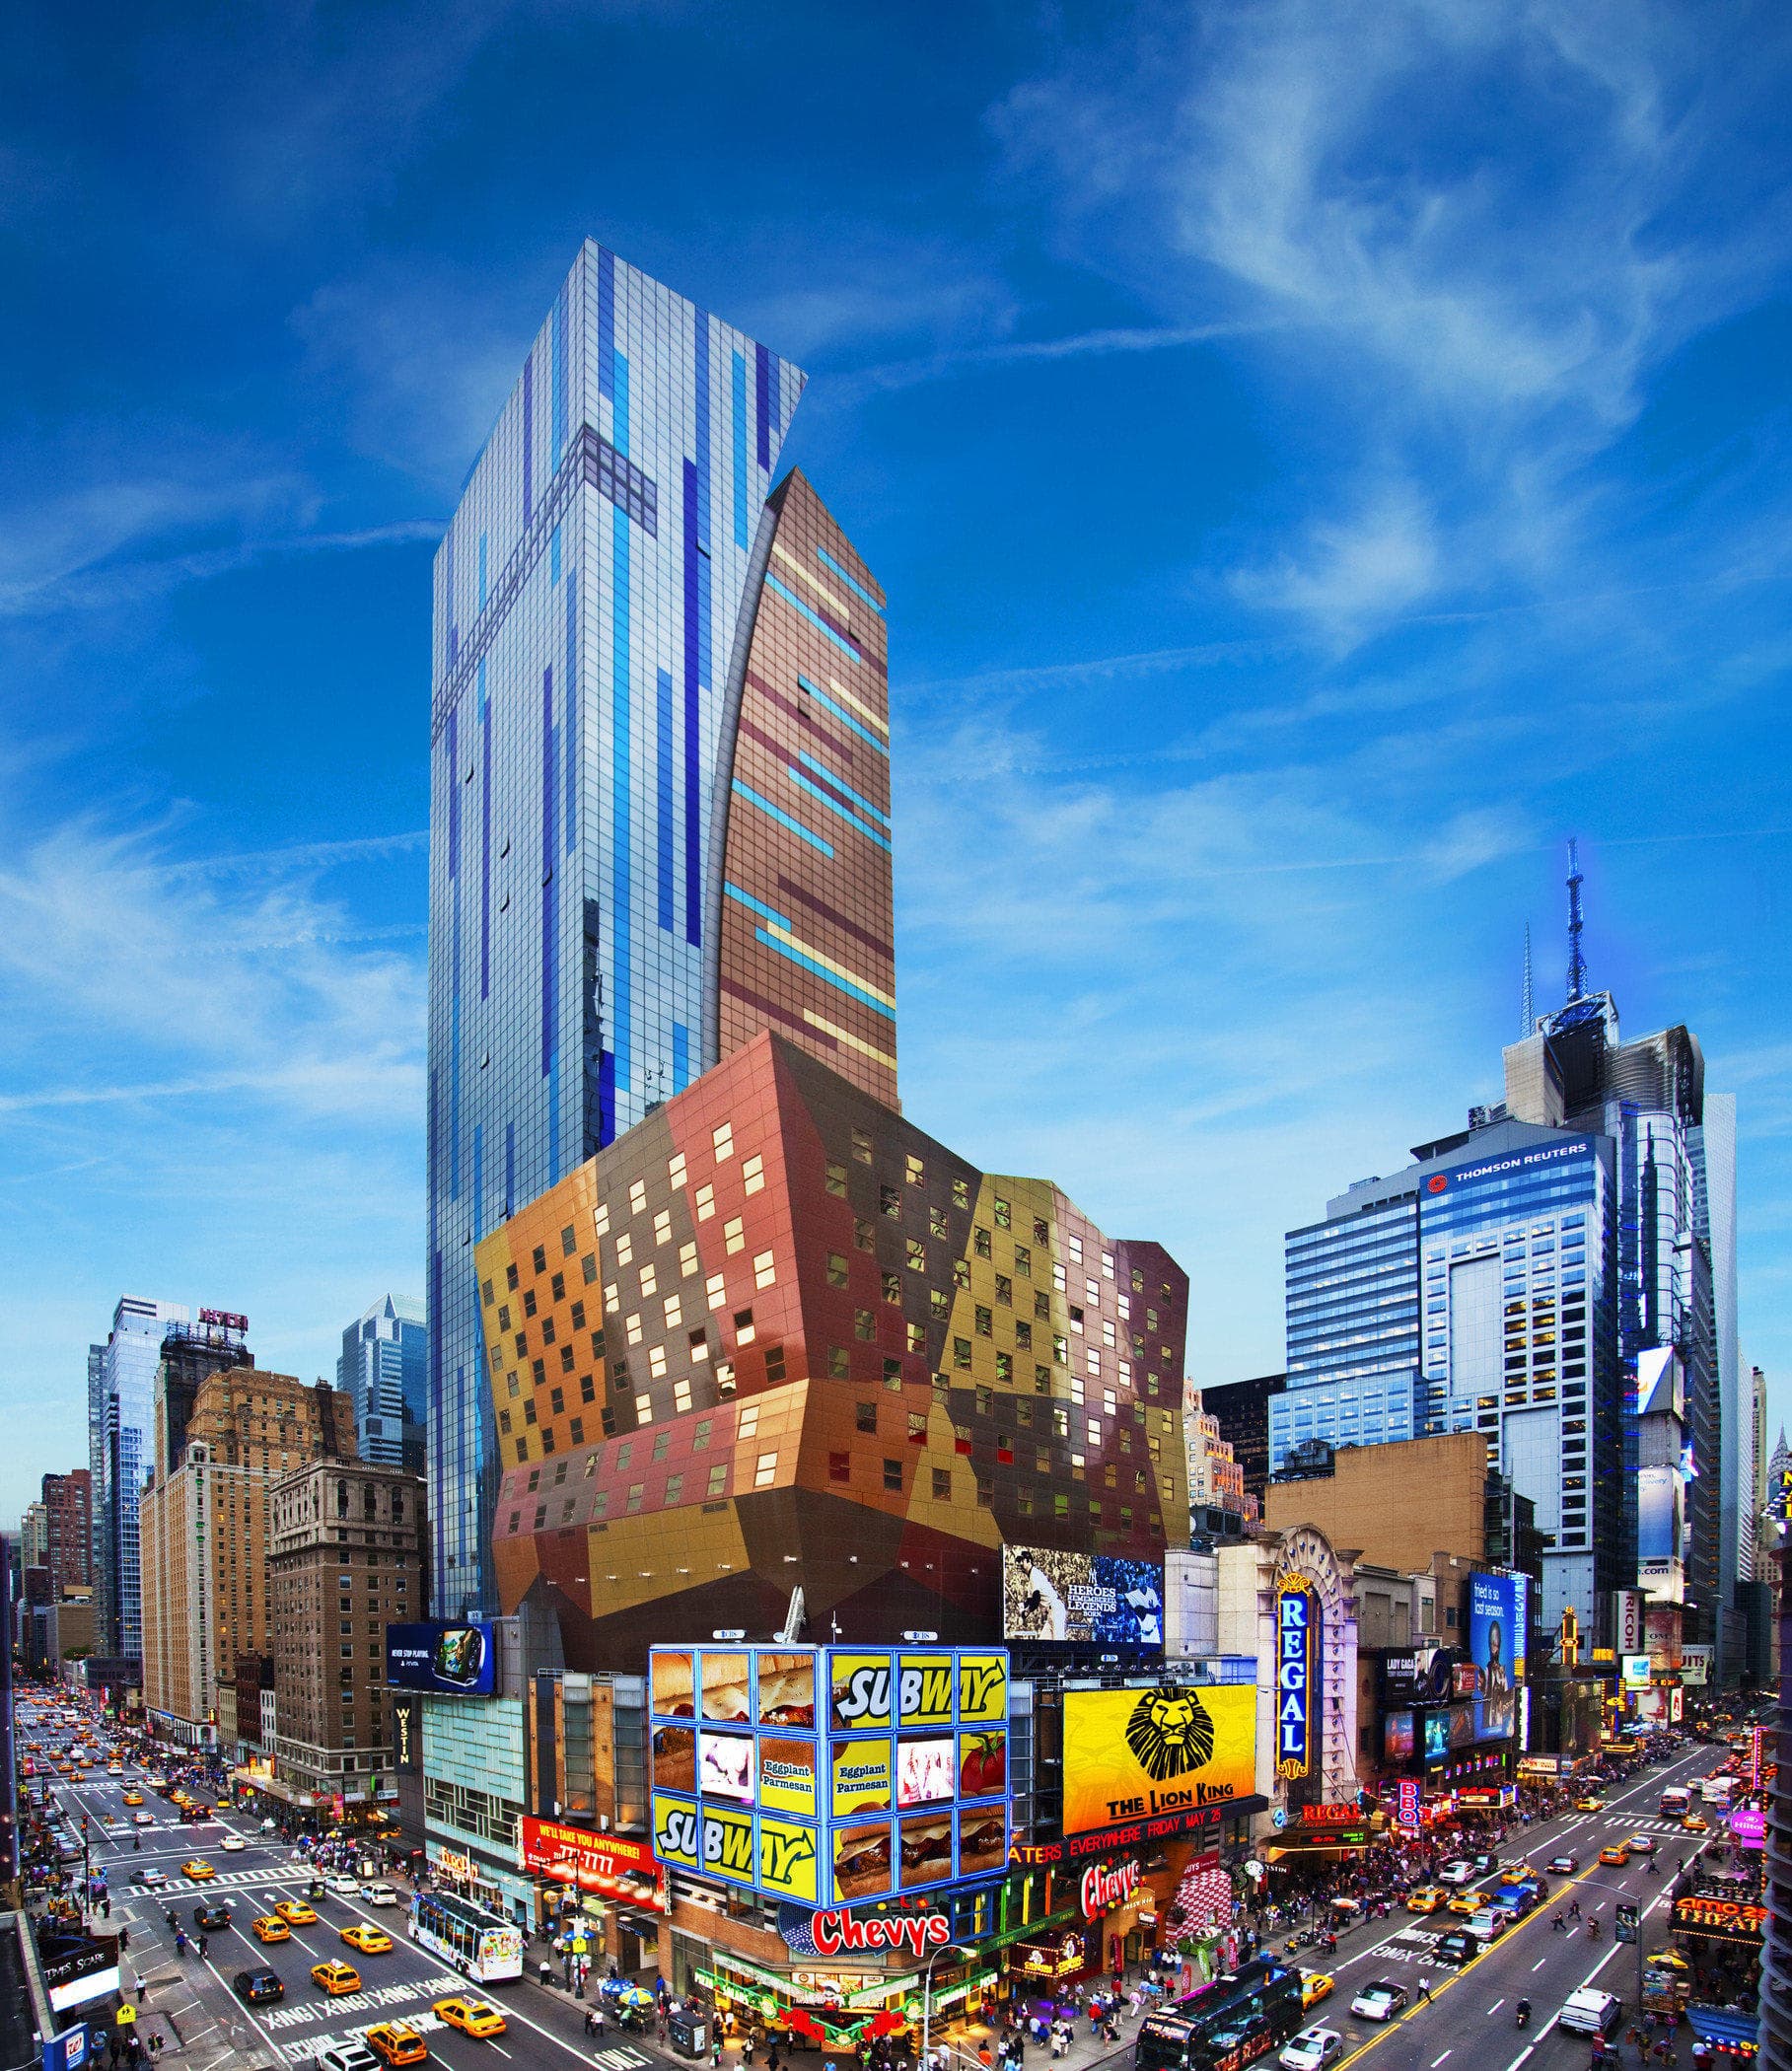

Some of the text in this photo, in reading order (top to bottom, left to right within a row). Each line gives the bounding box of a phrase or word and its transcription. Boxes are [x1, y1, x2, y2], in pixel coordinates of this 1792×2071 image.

[1456, 1143, 1588, 1181] THOMSON REUTERS
[1068, 1584, 1116, 1598] HEROES
[1473, 1583, 1500, 1600] fried is so
[1067, 1601, 1116, 1612] LEGENDS
[1473, 1600, 1484, 1614] last
[1624, 1596, 1634, 1649] RICOH
[1387, 1659, 1414, 1670] LADY GAGA
[1280, 1600, 1306, 1751] REGAL
[836, 1658, 1006, 1726] SUBWAY
[396, 1708, 410, 1764] WESTIN
[764, 1761, 810, 1778] Eggplant
[839, 1763, 886, 1779] Eggplant
[763, 1776, 813, 1793] Parmesan
[837, 1780, 888, 1793] Parmesan
[1107, 1797, 1146, 1818] THE
[1302, 1803, 1362, 1821] REGAL
[1398, 1782, 1417, 1824] BBQ
[539, 1824, 640, 1859] WE'LL TAKE YOU ANYWHERE!
[1070, 1825, 1141, 1856] EVERYWHERE
[1148, 1816, 1181, 1837] FRIDAY
[1184, 1811, 1206, 1829] MAY
[1210, 1808, 1222, 1823] 25
[657, 1810, 816, 1885] SUBWAY
[812, 1908, 950, 1958] Chevys
[1029, 1922, 1045, 1934] FRESH
[997, 1936, 1014, 1947] FRESH
[595, 2045, 653, 2071] ONLY
